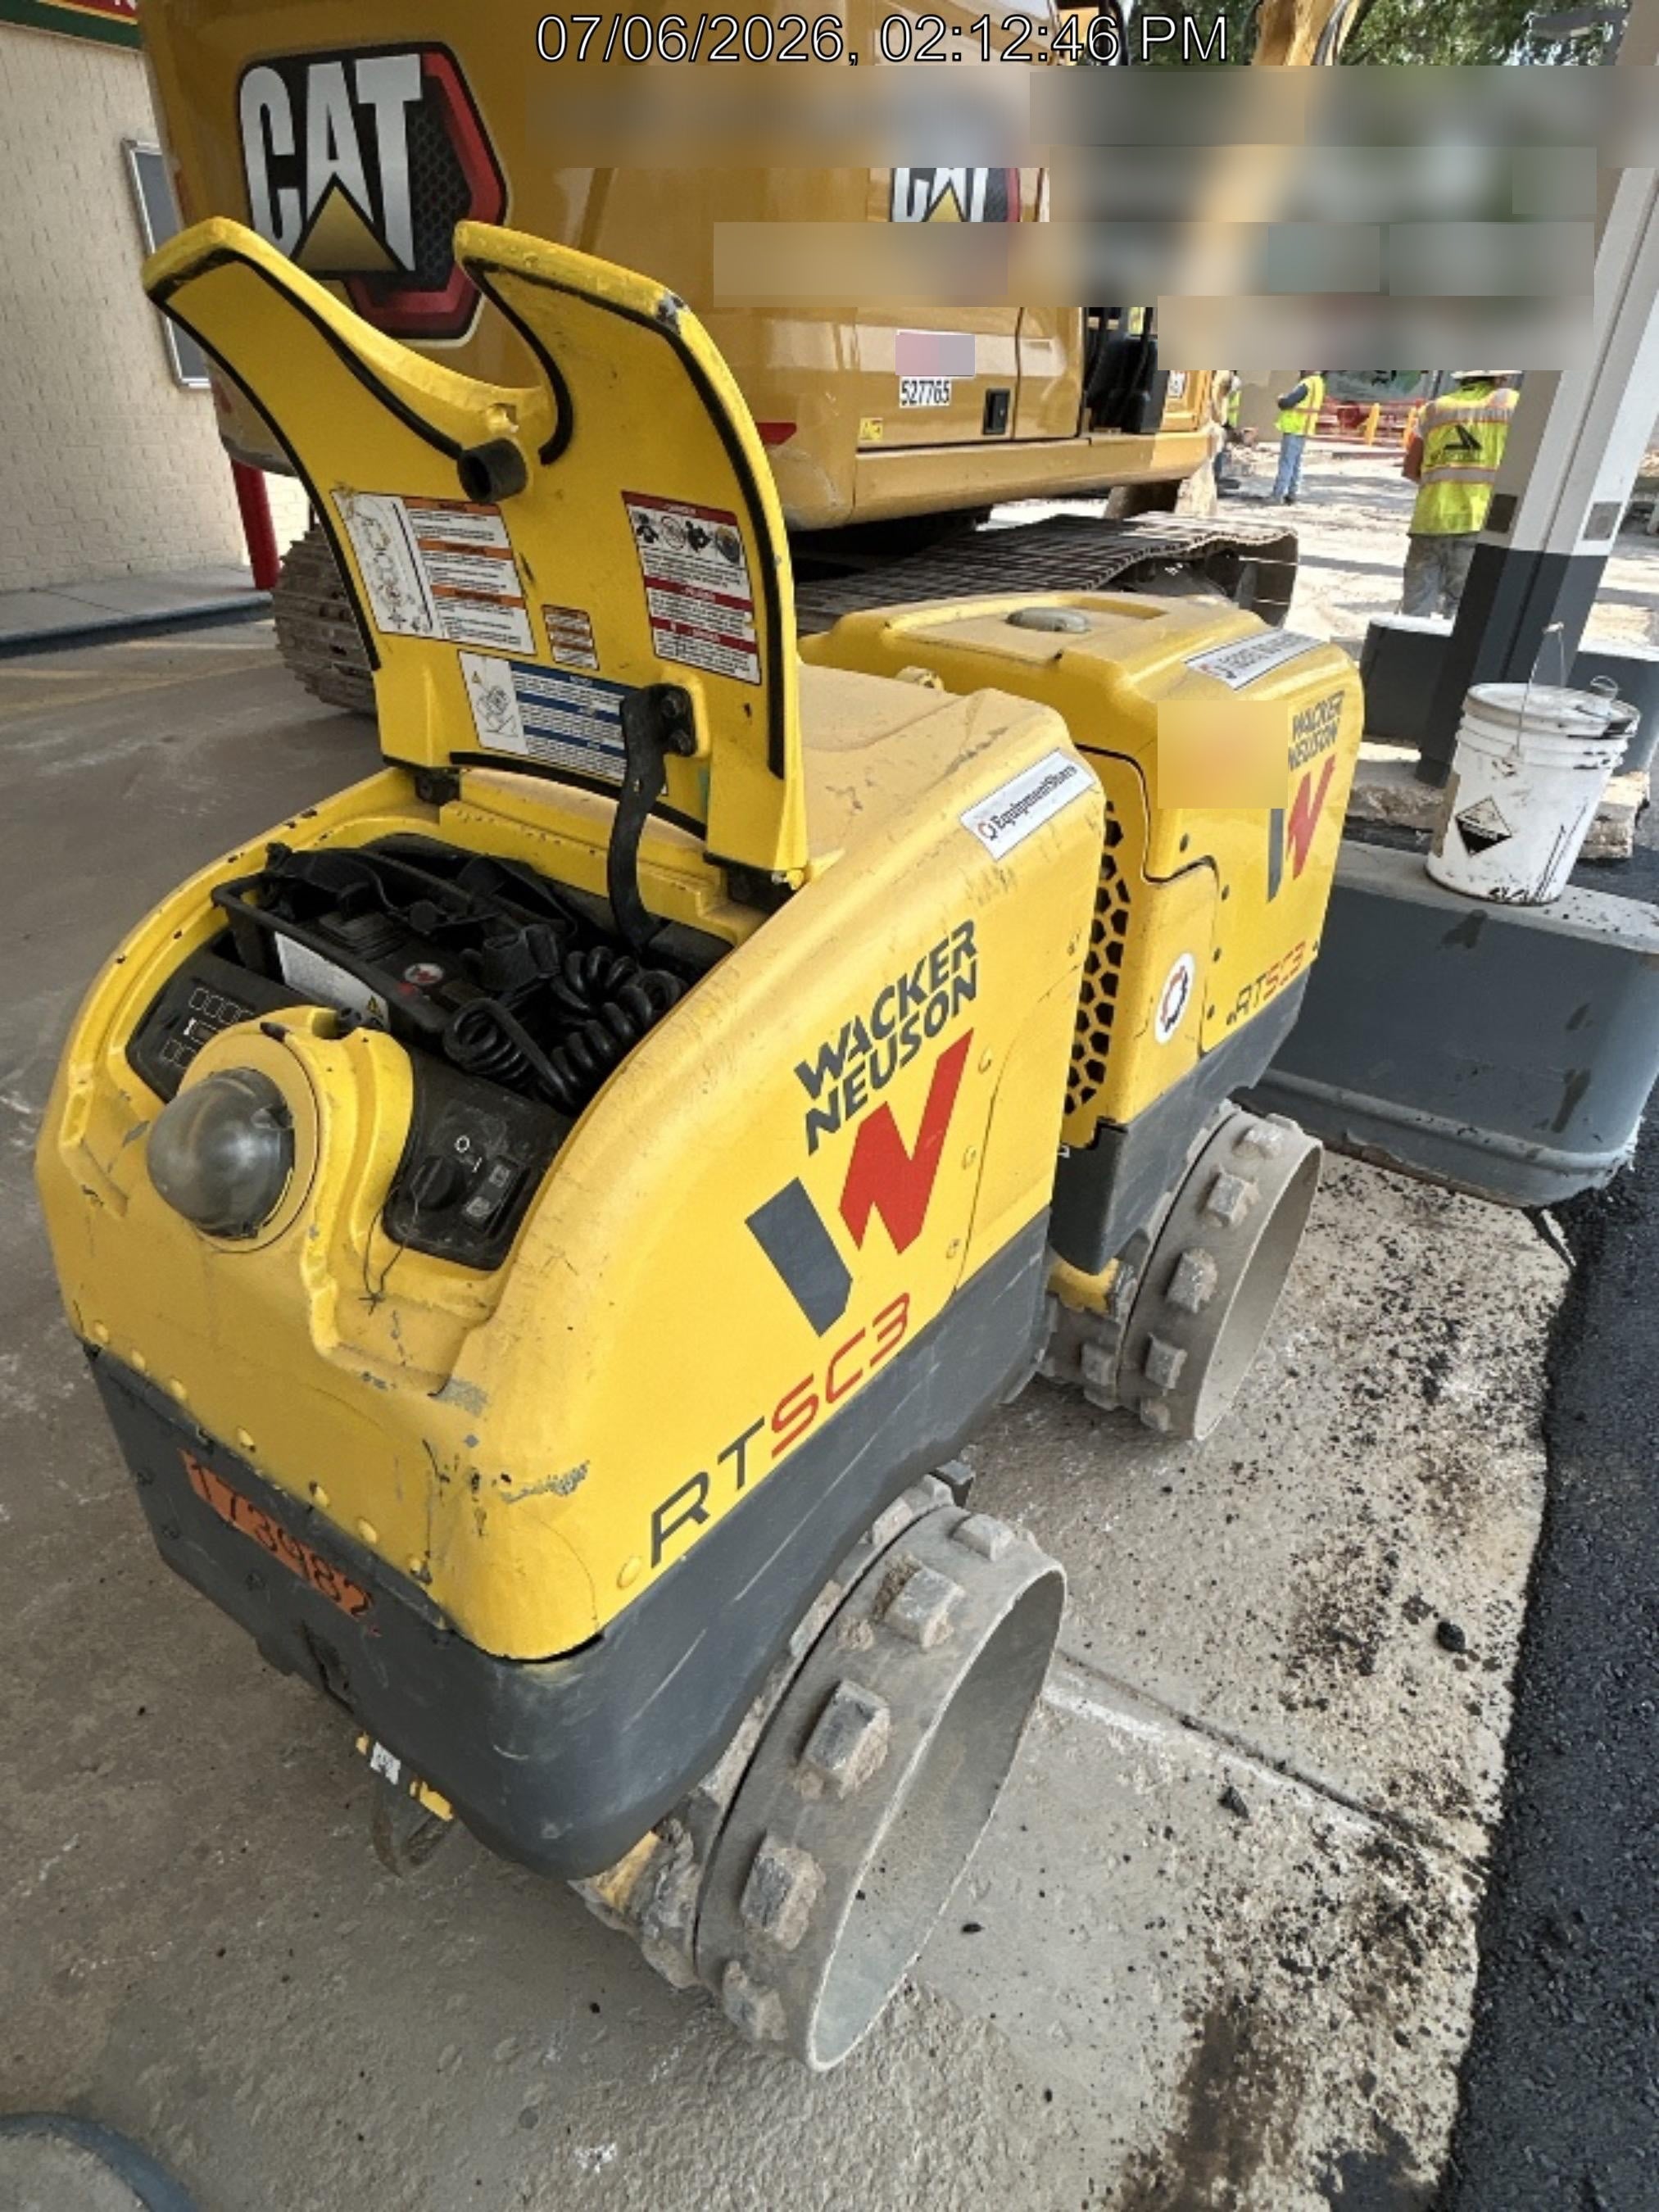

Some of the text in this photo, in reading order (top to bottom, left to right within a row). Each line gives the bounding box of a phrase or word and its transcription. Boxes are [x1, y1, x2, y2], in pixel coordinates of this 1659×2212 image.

[240, 53, 422, 271] CAT
[901, 379, 950, 406] 527765
[793, 918, 979, 1100] WACKER
[805, 959, 978, 1157] NEUSON
[650, 1292, 910, 1568] RTSC3
